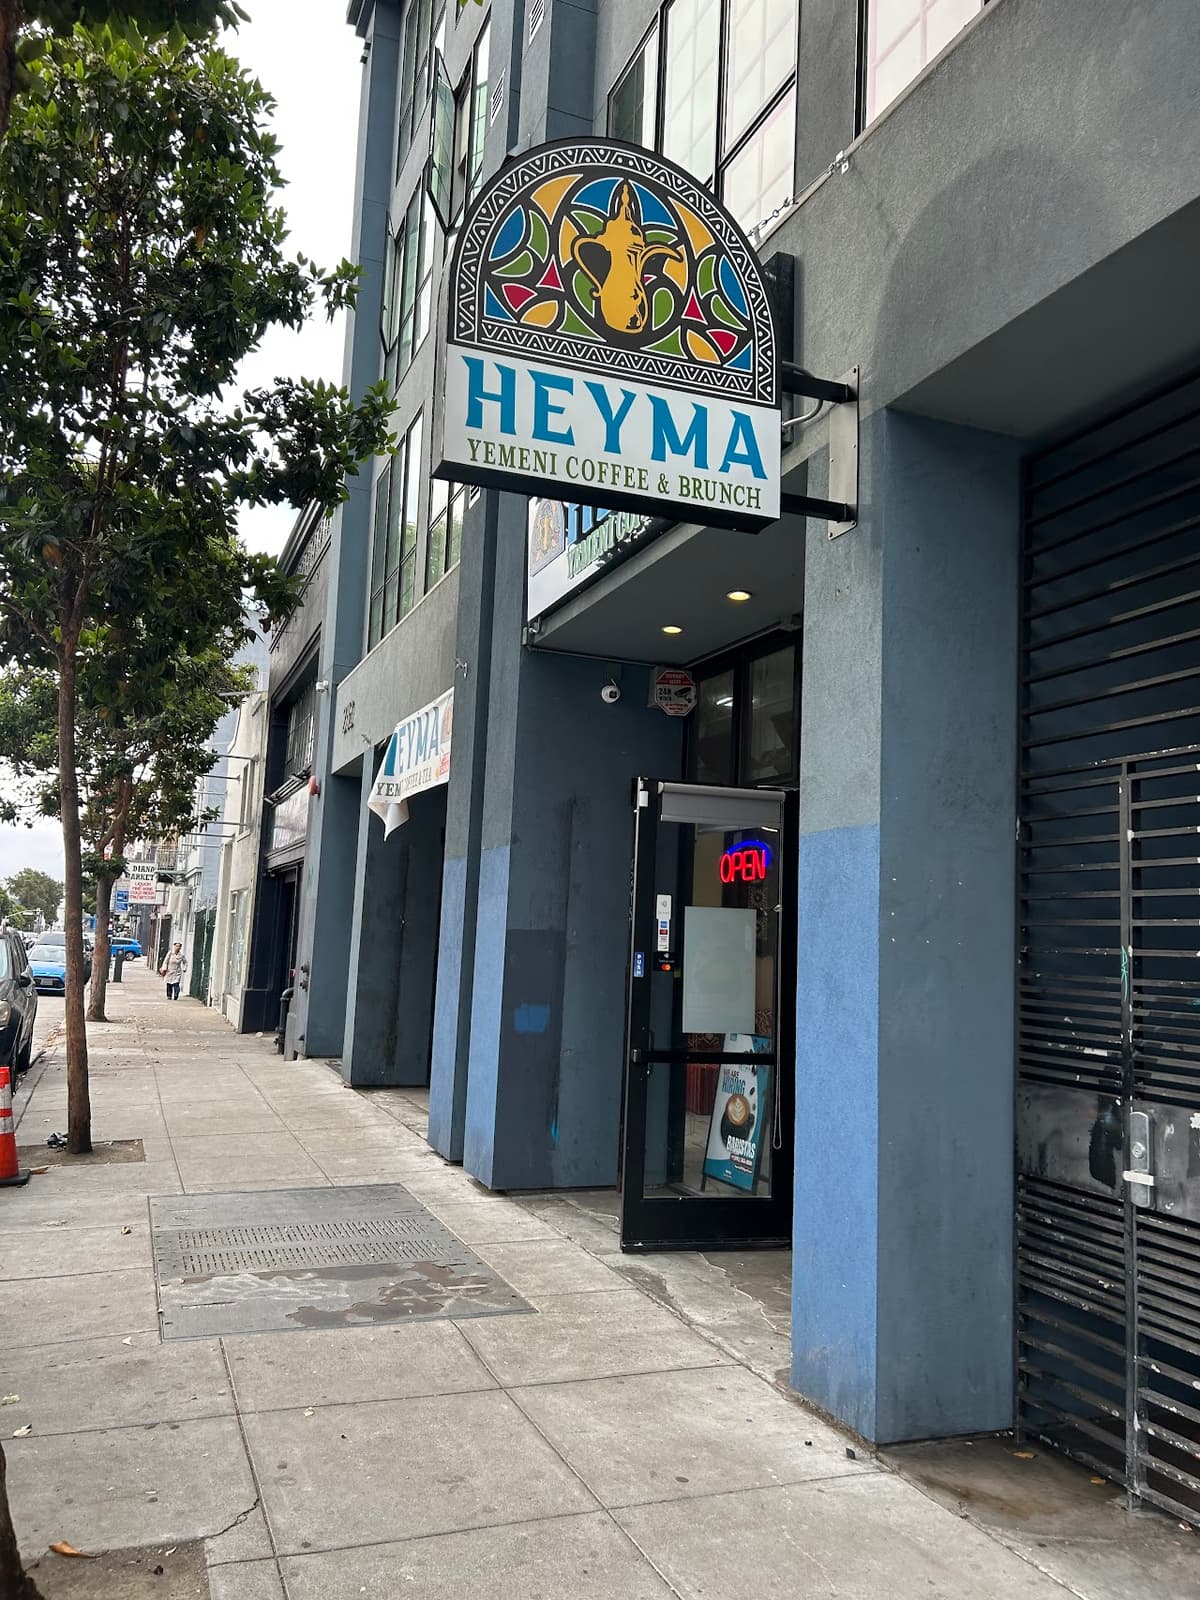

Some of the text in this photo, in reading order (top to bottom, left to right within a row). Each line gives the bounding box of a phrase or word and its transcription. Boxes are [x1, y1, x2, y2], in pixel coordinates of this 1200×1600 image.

[461, 355, 768, 480] HEYMA
[467, 438, 761, 510] YEMENI COFFEE & BRUNCH
[384, 706, 439, 776] EYMA
[720, 850, 766, 883] OPEN
